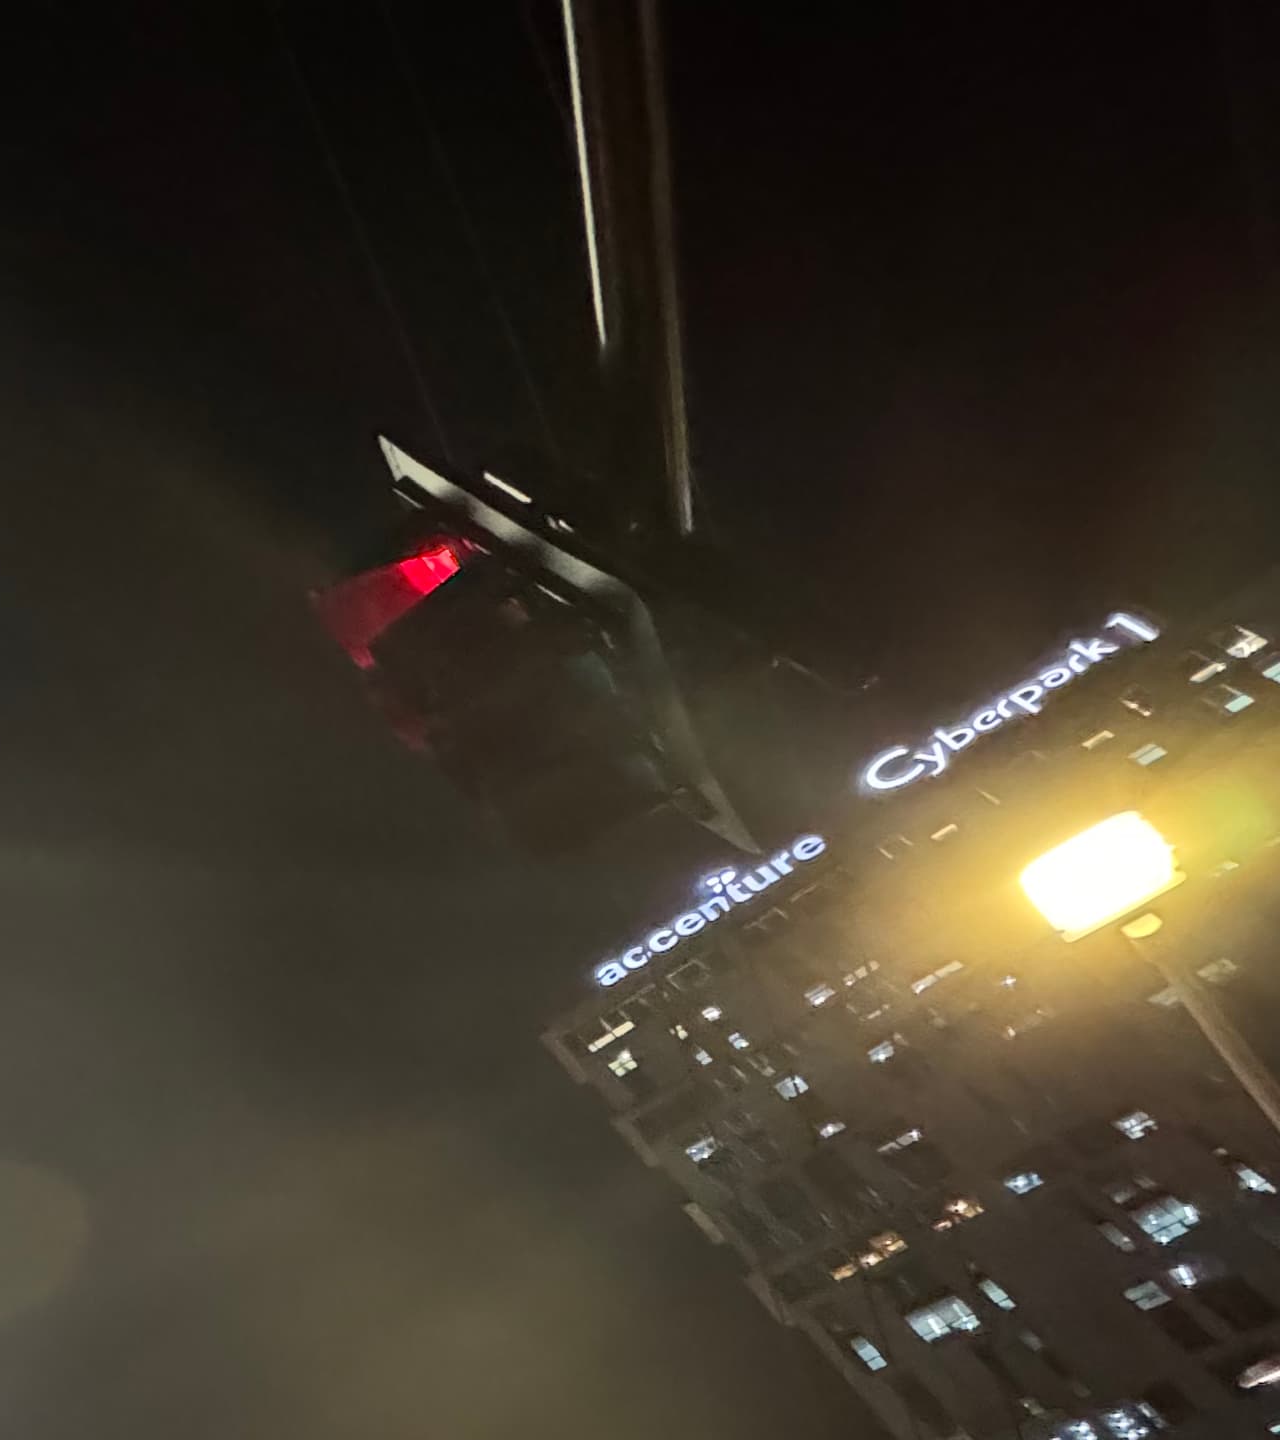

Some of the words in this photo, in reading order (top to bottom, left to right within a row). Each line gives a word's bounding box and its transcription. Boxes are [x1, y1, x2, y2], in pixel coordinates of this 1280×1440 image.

[864, 638, 1120, 790] Cyberpark
[1104, 611, 1160, 642] 1
[596, 835, 827, 987] accenture
